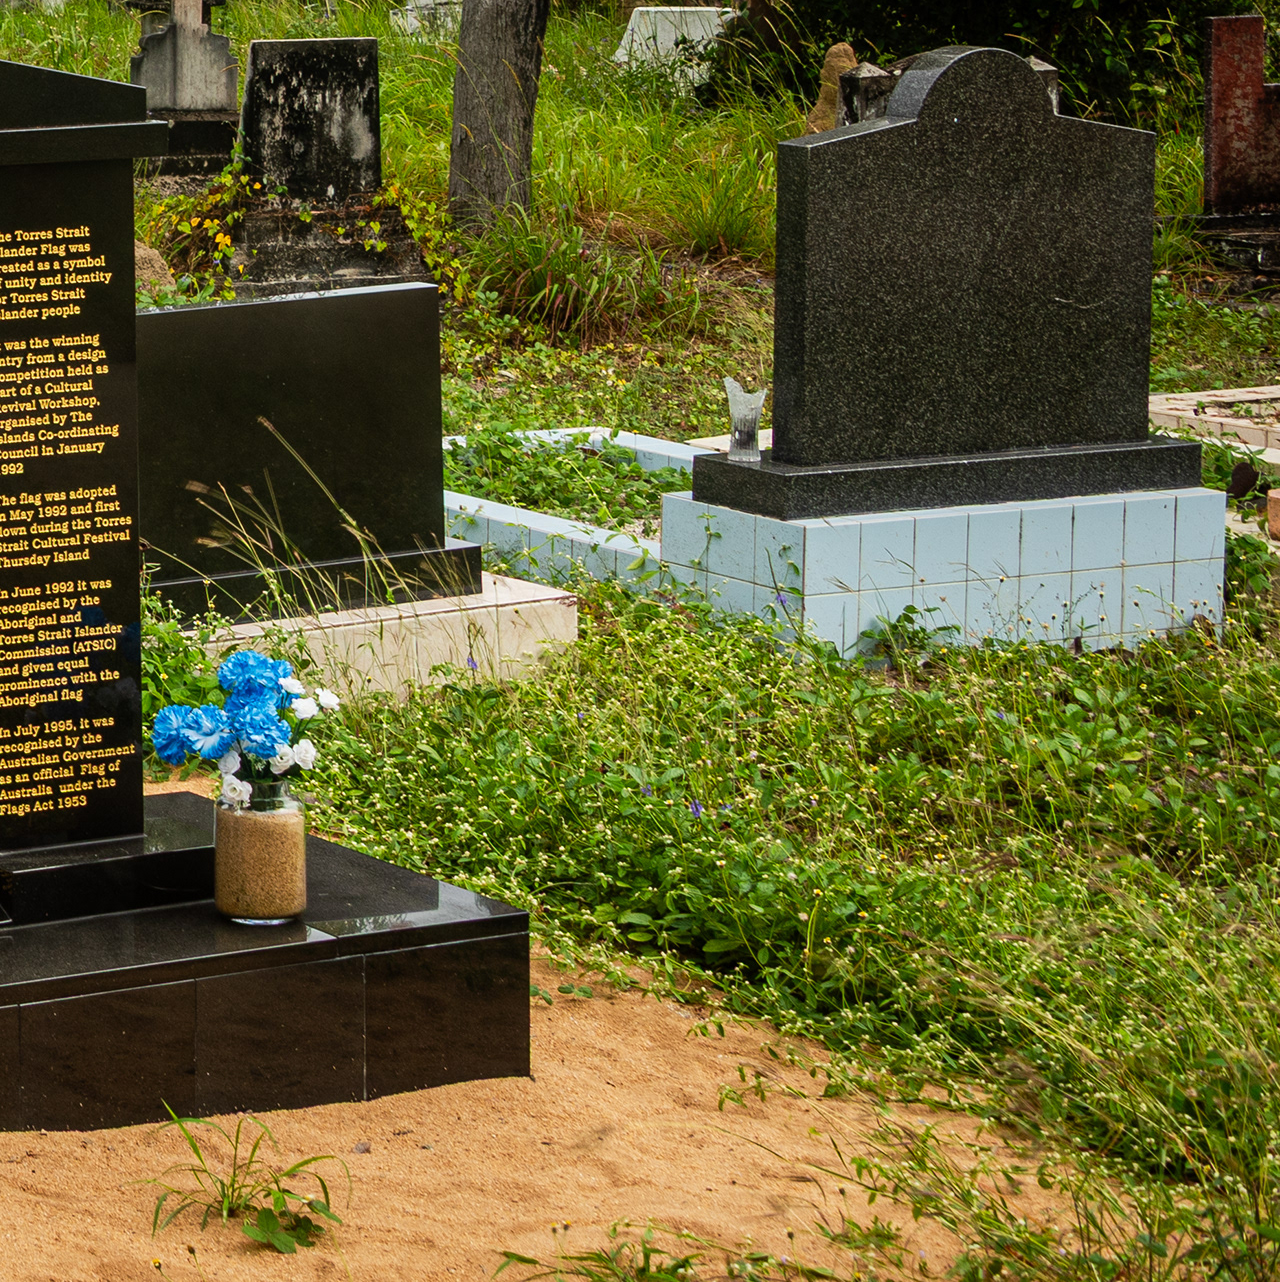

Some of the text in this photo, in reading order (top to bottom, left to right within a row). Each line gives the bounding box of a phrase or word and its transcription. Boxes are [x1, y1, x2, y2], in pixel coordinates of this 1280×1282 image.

[14, 230, 53, 241] Torres
[55, 225, 90, 238] Strait
[40, 243, 66, 256] Flag
[68, 243, 90, 252] was
[37, 261, 50, 270] as
[52, 260, 60, 269] a
[62, 254, 105, 271] symbol
[4, 276, 37, 289] unity
[39, 273, 62, 285] and
[64, 270, 112, 284] identity
[9, 292, 48, 303] Torres
[51, 287, 85, 300] Strait
[41, 303, 80, 320] people
[13, 723, 40, 737] July
[79, 718, 89, 729] it
[92, 717, 114, 727] was
[64, 735, 79, 748] by
[82, 732, 102, 744] the
[62, 743, 134, 761] Government
[14, 773, 30, 782] an
[32, 765, 74, 780] official
[80, 763, 105, 775] Flag
[108, 759, 120, 771] of
[58, 780, 93, 792] under
[96, 777, 116, 788] the
[0, 794, 86, 816] Flags Act 1953
